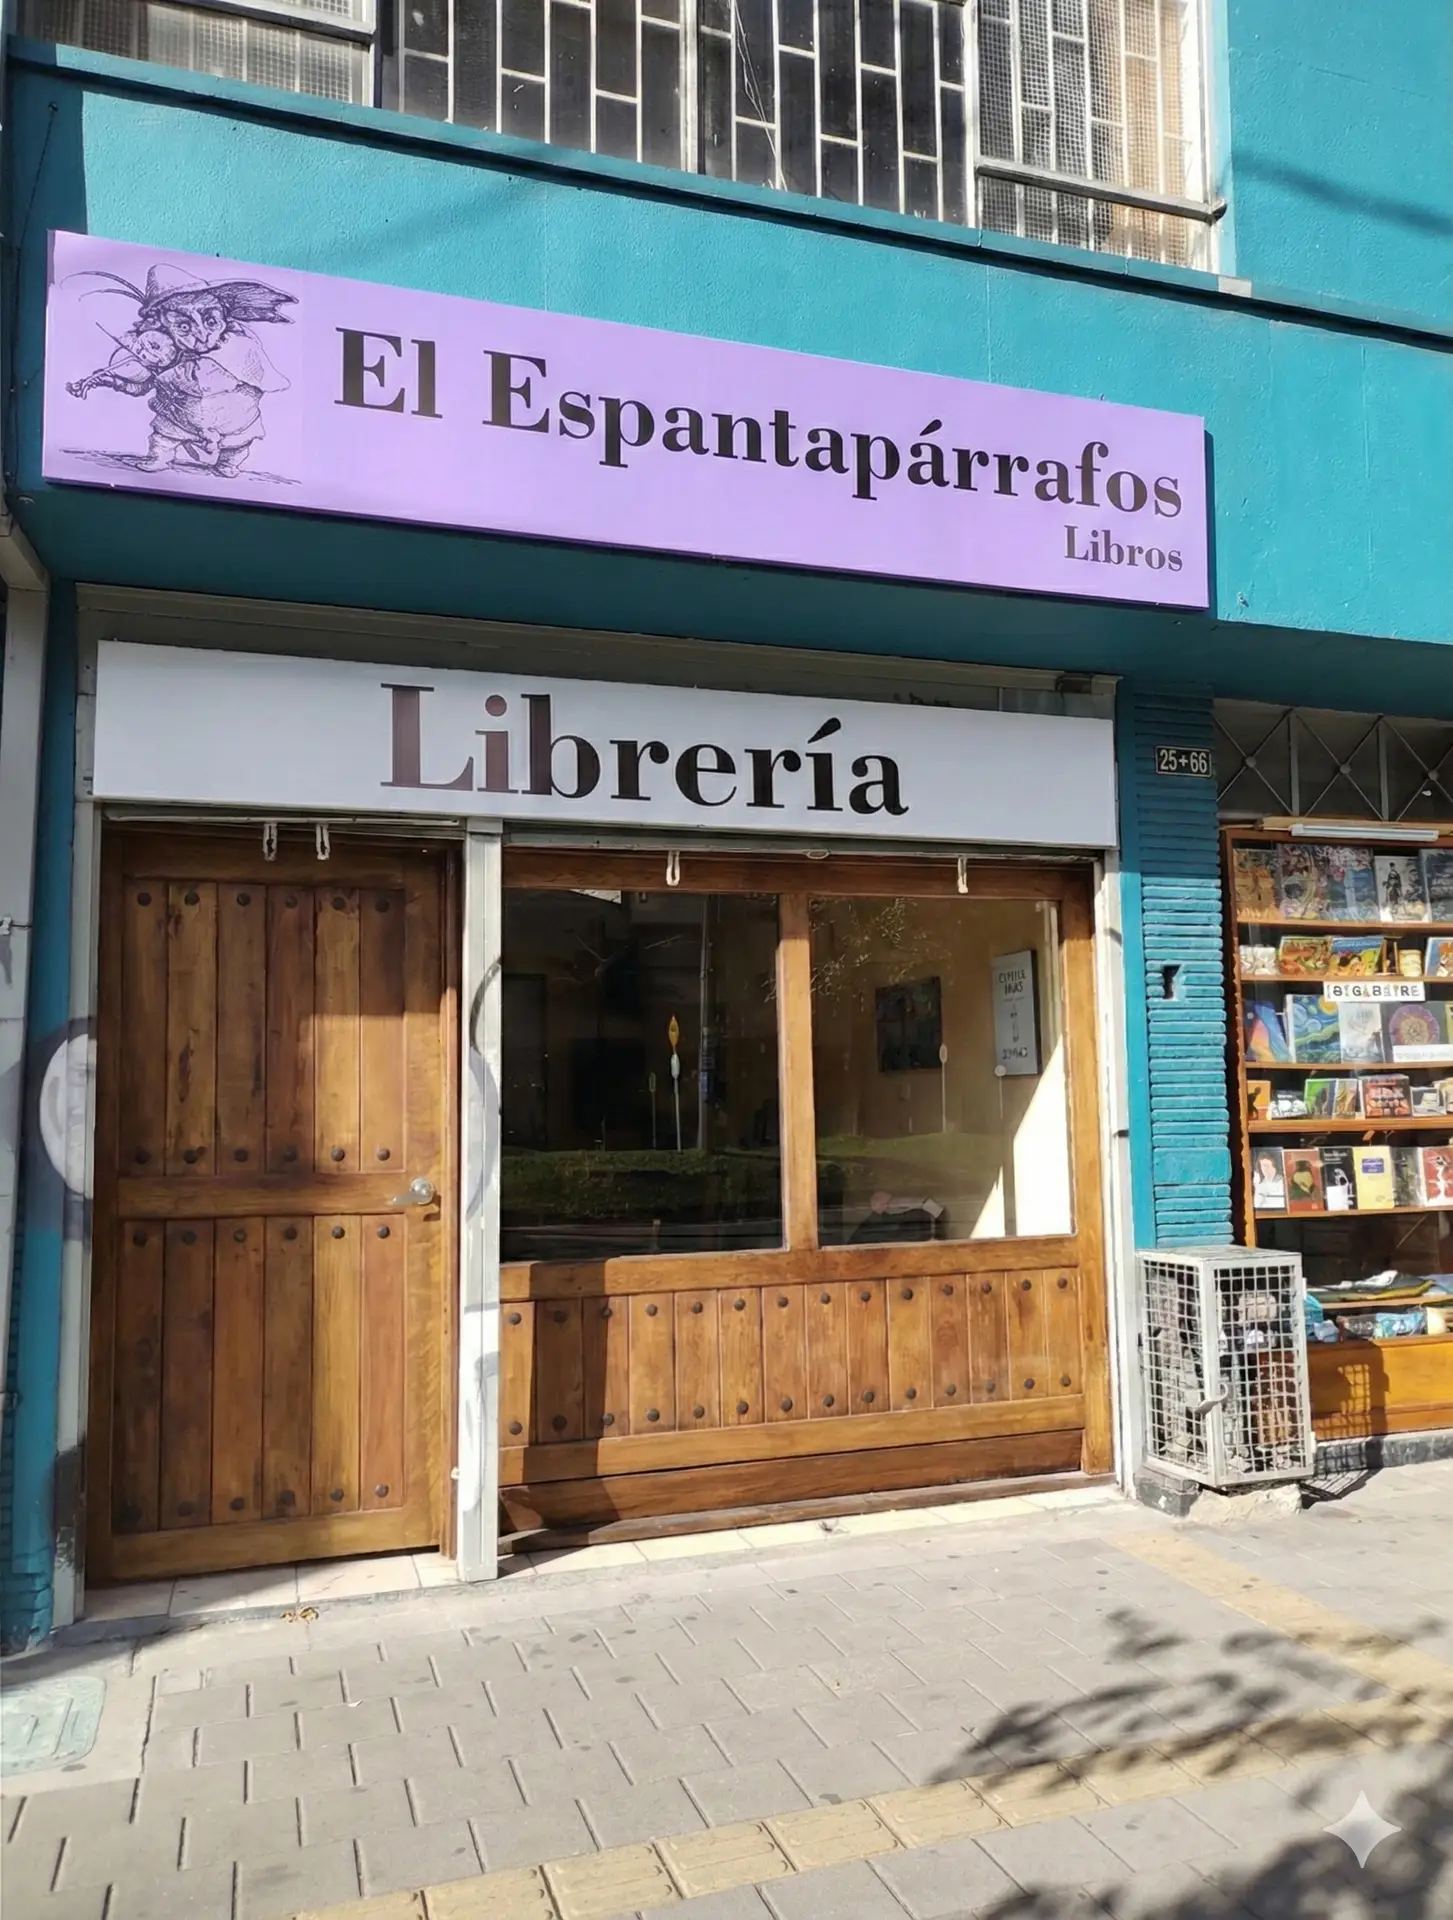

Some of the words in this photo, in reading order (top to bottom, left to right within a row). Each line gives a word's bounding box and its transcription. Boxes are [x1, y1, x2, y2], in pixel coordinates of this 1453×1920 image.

[333, 326, 443, 420] El
[482, 349, 1183, 519] Espantapárrafos
[1063, 525, 1184, 573] Libros
[380, 682, 910, 817] Librería
